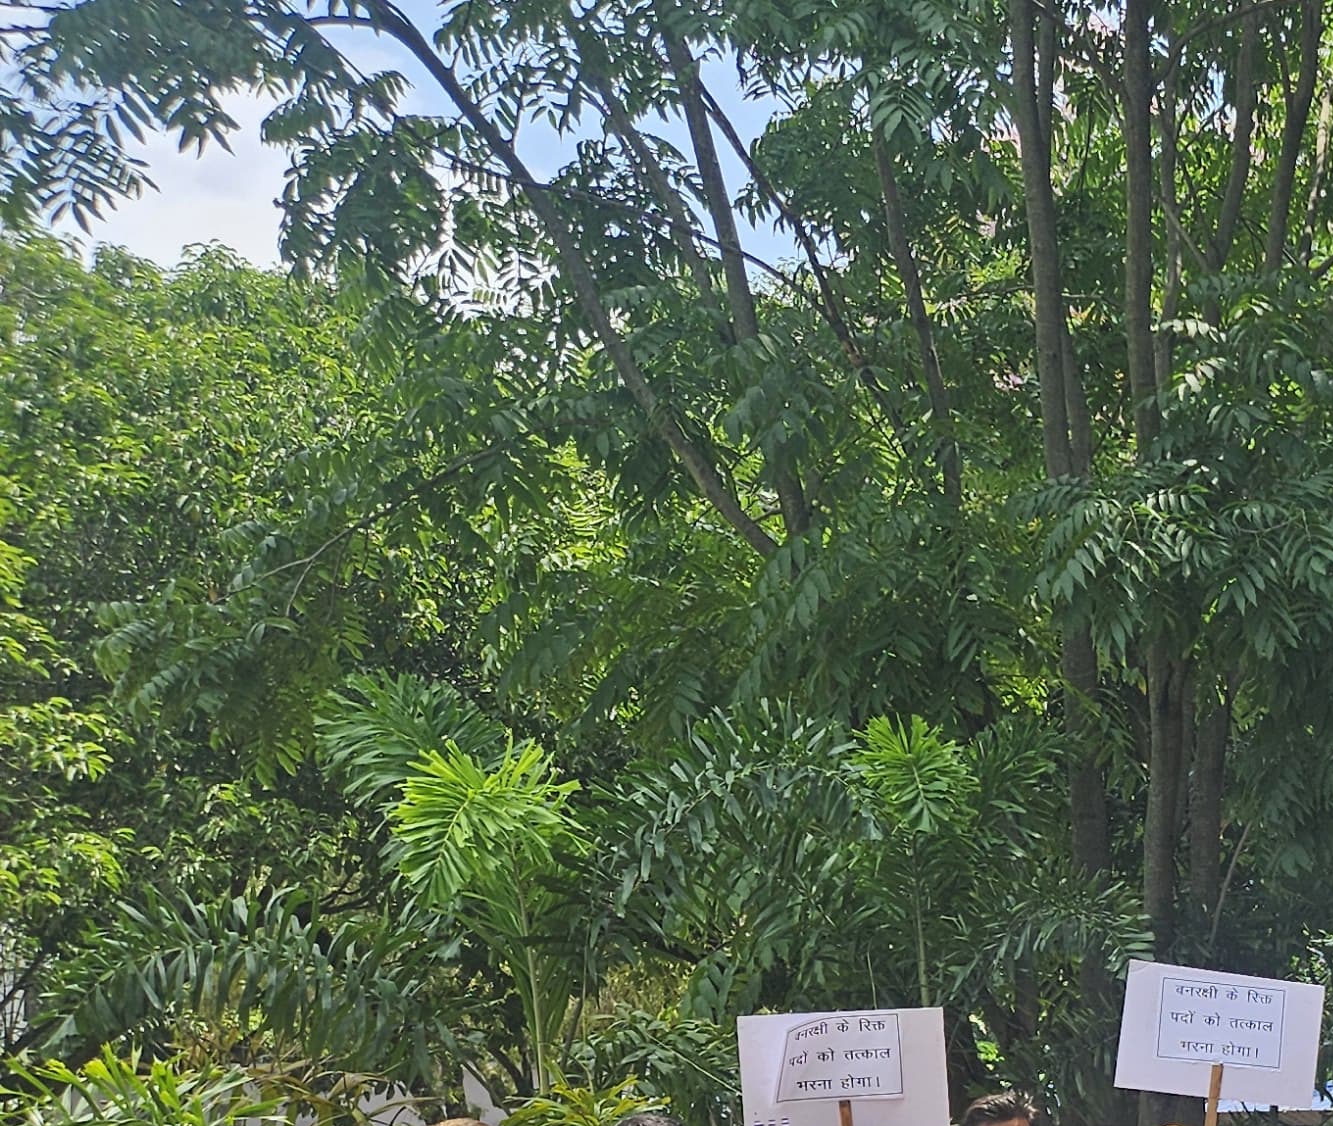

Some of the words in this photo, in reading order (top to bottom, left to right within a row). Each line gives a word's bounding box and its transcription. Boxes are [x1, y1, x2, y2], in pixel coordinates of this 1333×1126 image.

[1176, 985, 1217, 999] वनरक्षी
[1227, 988, 1239, 1001] के
[1248, 990, 1272, 1005] रिक्त
[837, 1020, 849, 1033] के
[859, 1018, 886, 1032] रिक्त
[1171, 1010, 1195, 1023] पदों
[1204, 1013, 1220, 1027] को
[1230, 1018, 1272, 1031] तत्काल
[1181, 1041, 1213, 1053] भरना
[789, 1050, 807, 1067] पदों
[817, 1048, 834, 1062] को
[844, 1049, 891, 1060] तत्काल
[797, 1079, 832, 1091] भरना
